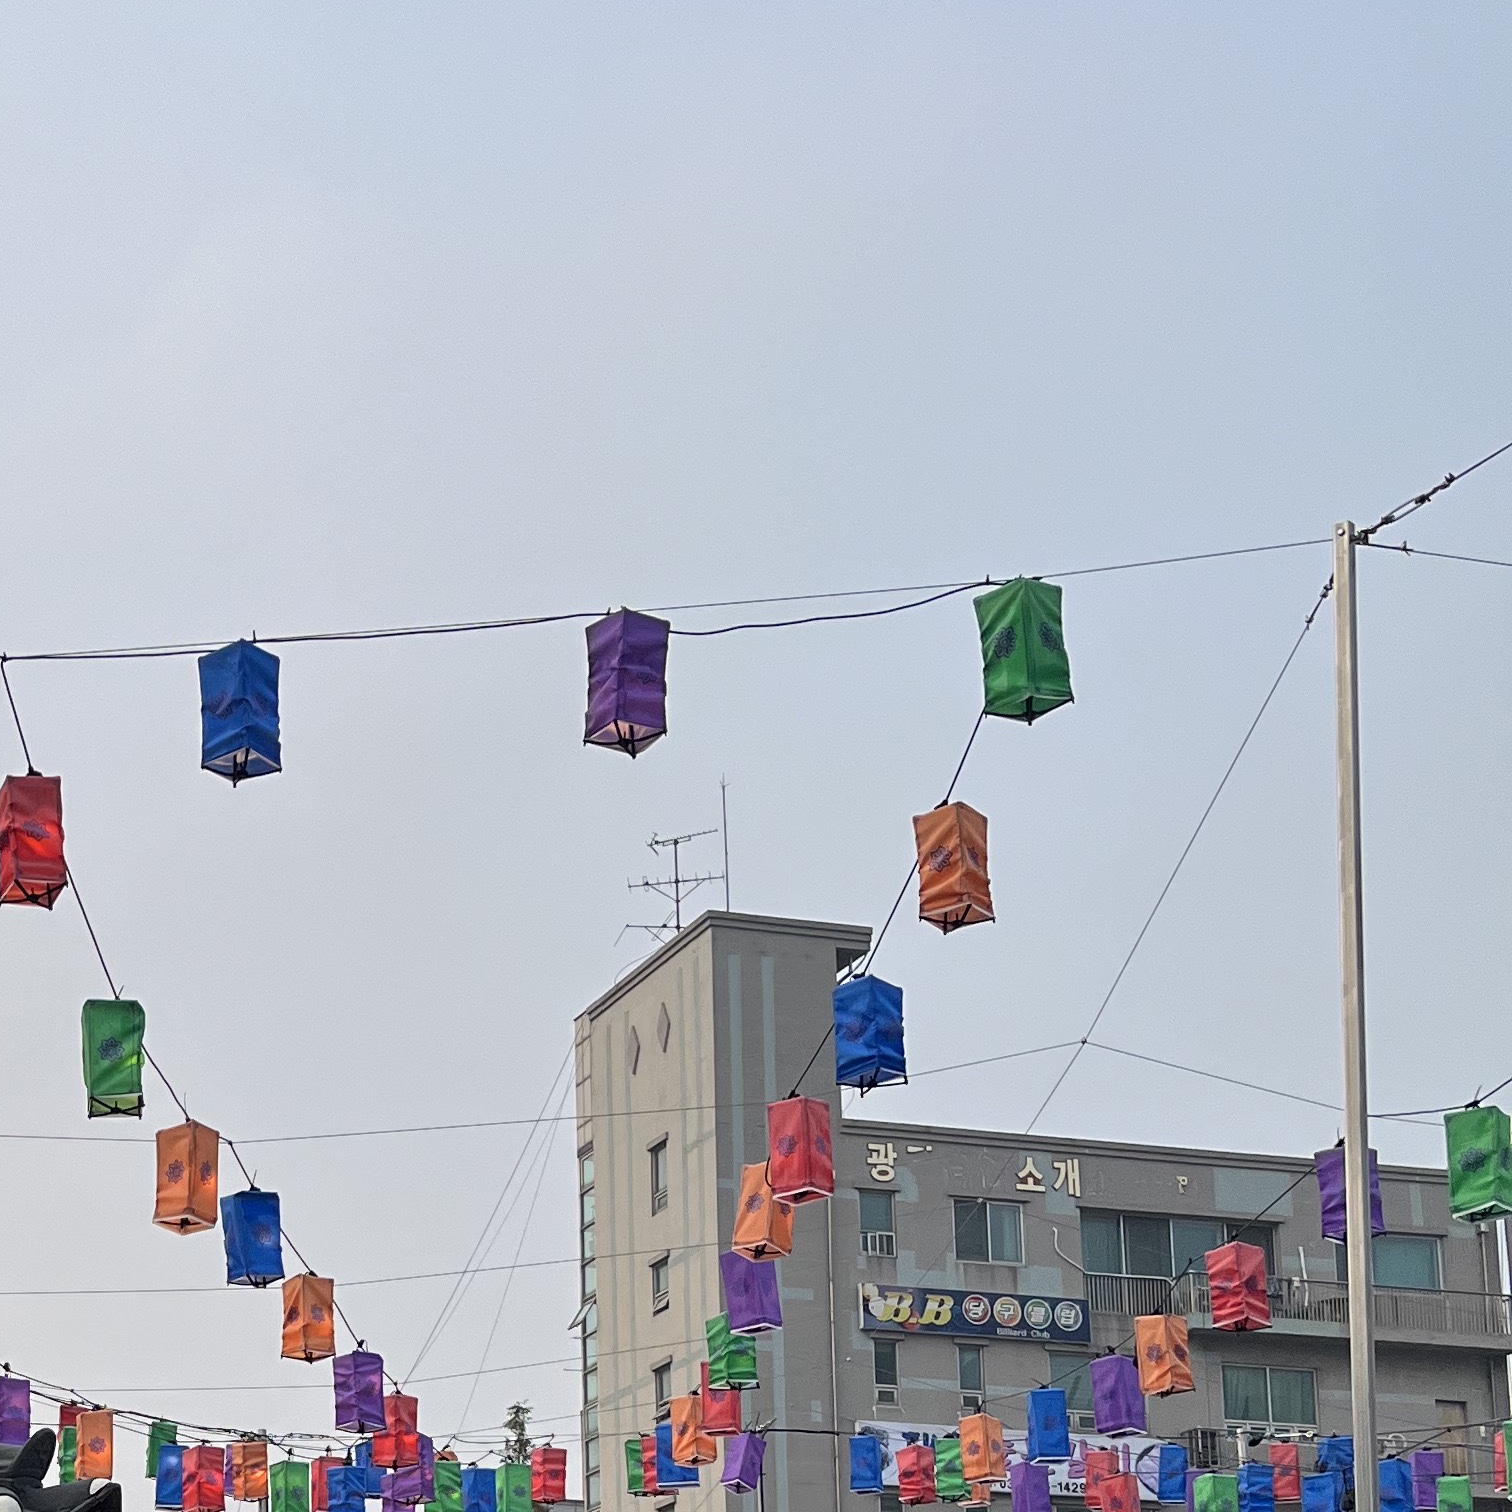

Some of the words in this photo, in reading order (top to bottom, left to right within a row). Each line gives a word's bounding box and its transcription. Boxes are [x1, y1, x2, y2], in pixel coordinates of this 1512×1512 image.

[866, 1142, 898, 1182] 광
[1015, 1156, 1081, 1197] 소개
[876, 1291, 954, 1325] B.B
[965, 1298, 1078, 1326] 당구클럽
[1031, 1329, 1051, 1338] Club
